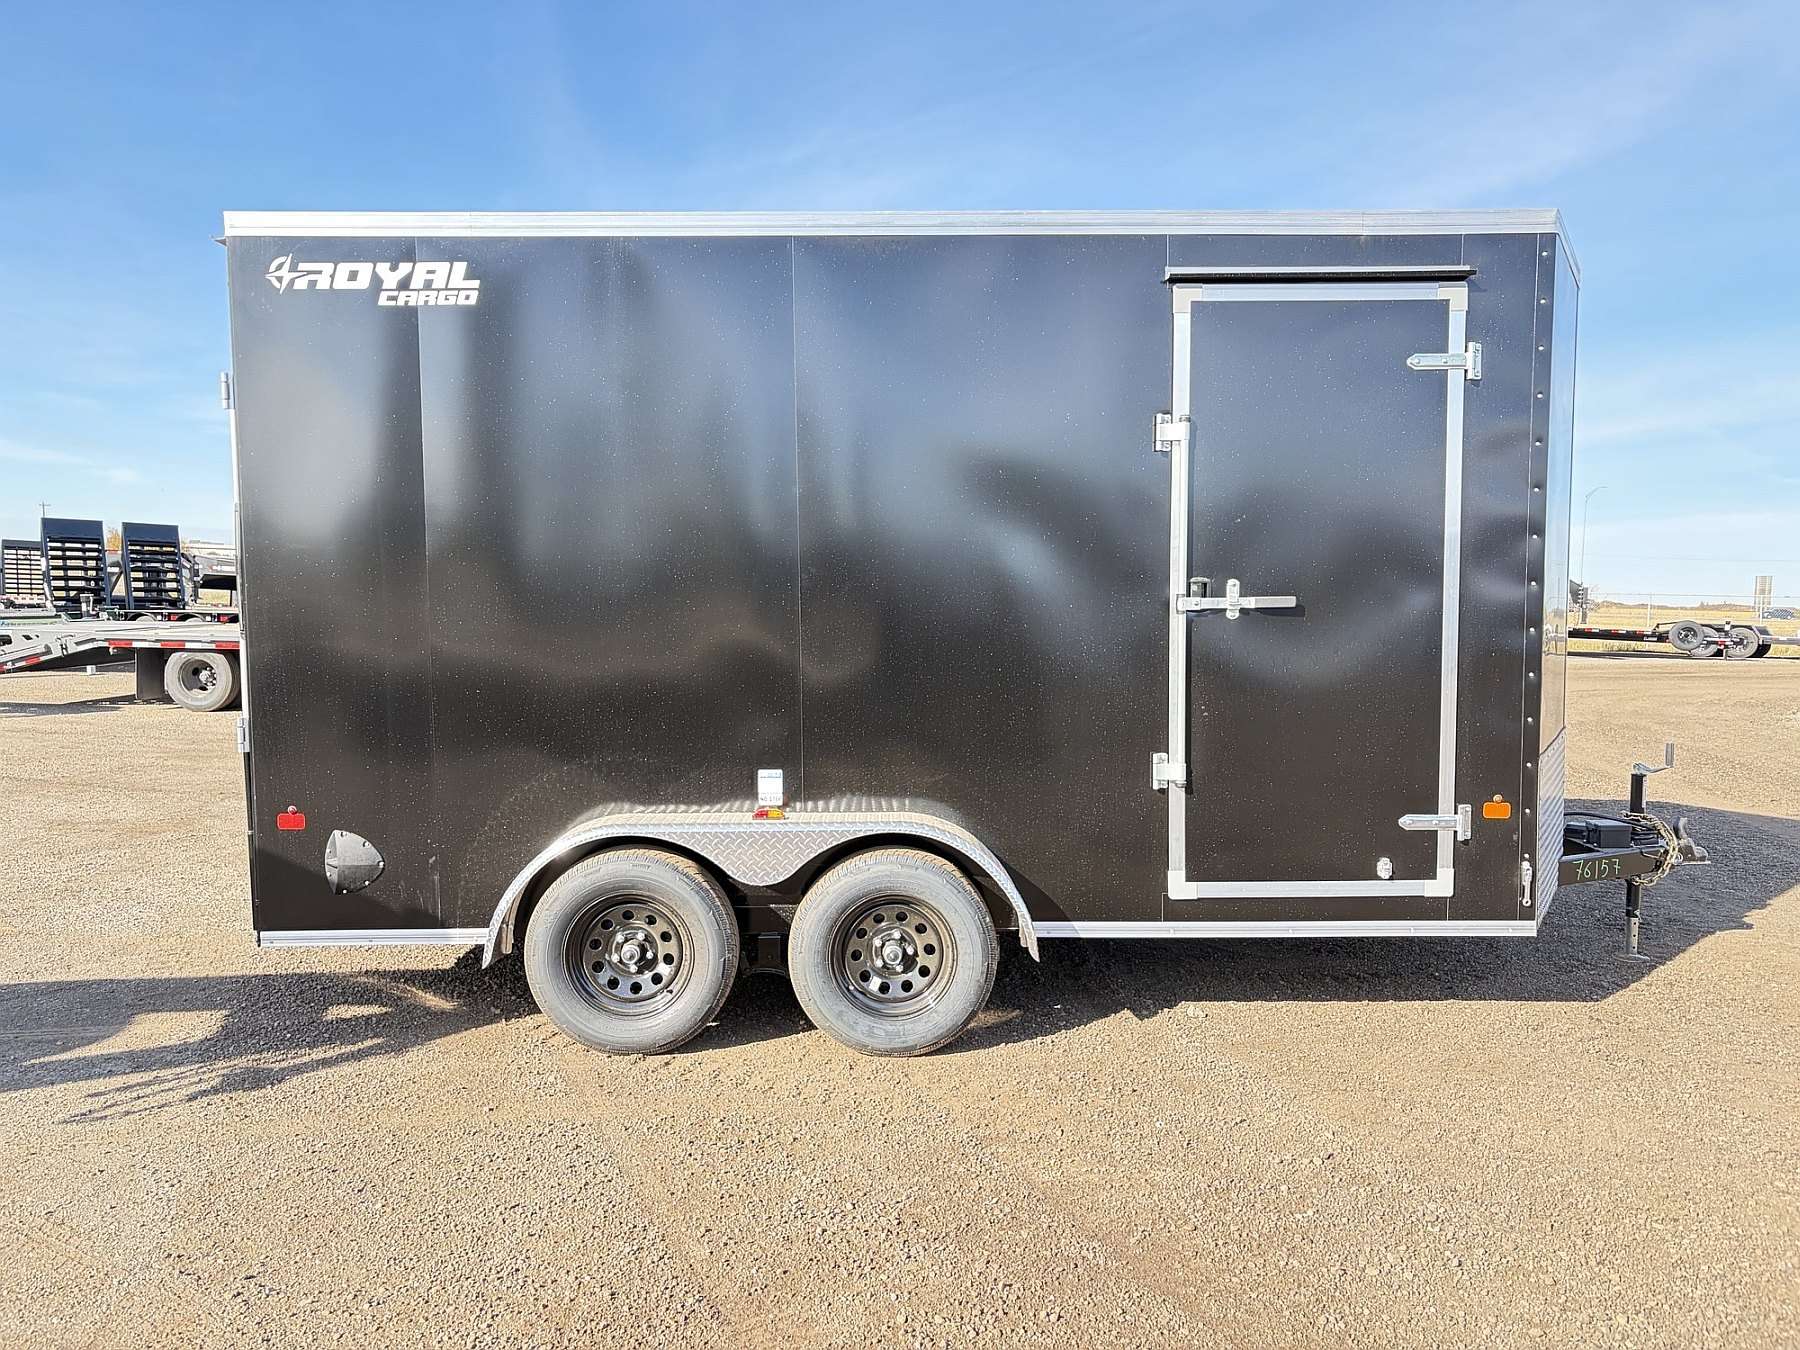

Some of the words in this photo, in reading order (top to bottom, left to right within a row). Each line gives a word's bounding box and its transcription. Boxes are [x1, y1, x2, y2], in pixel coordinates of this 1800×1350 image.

[293, 261, 481, 290] ROYAL
[377, 290, 479, 306] CARGO
[1573, 858, 1621, 880] 76157
